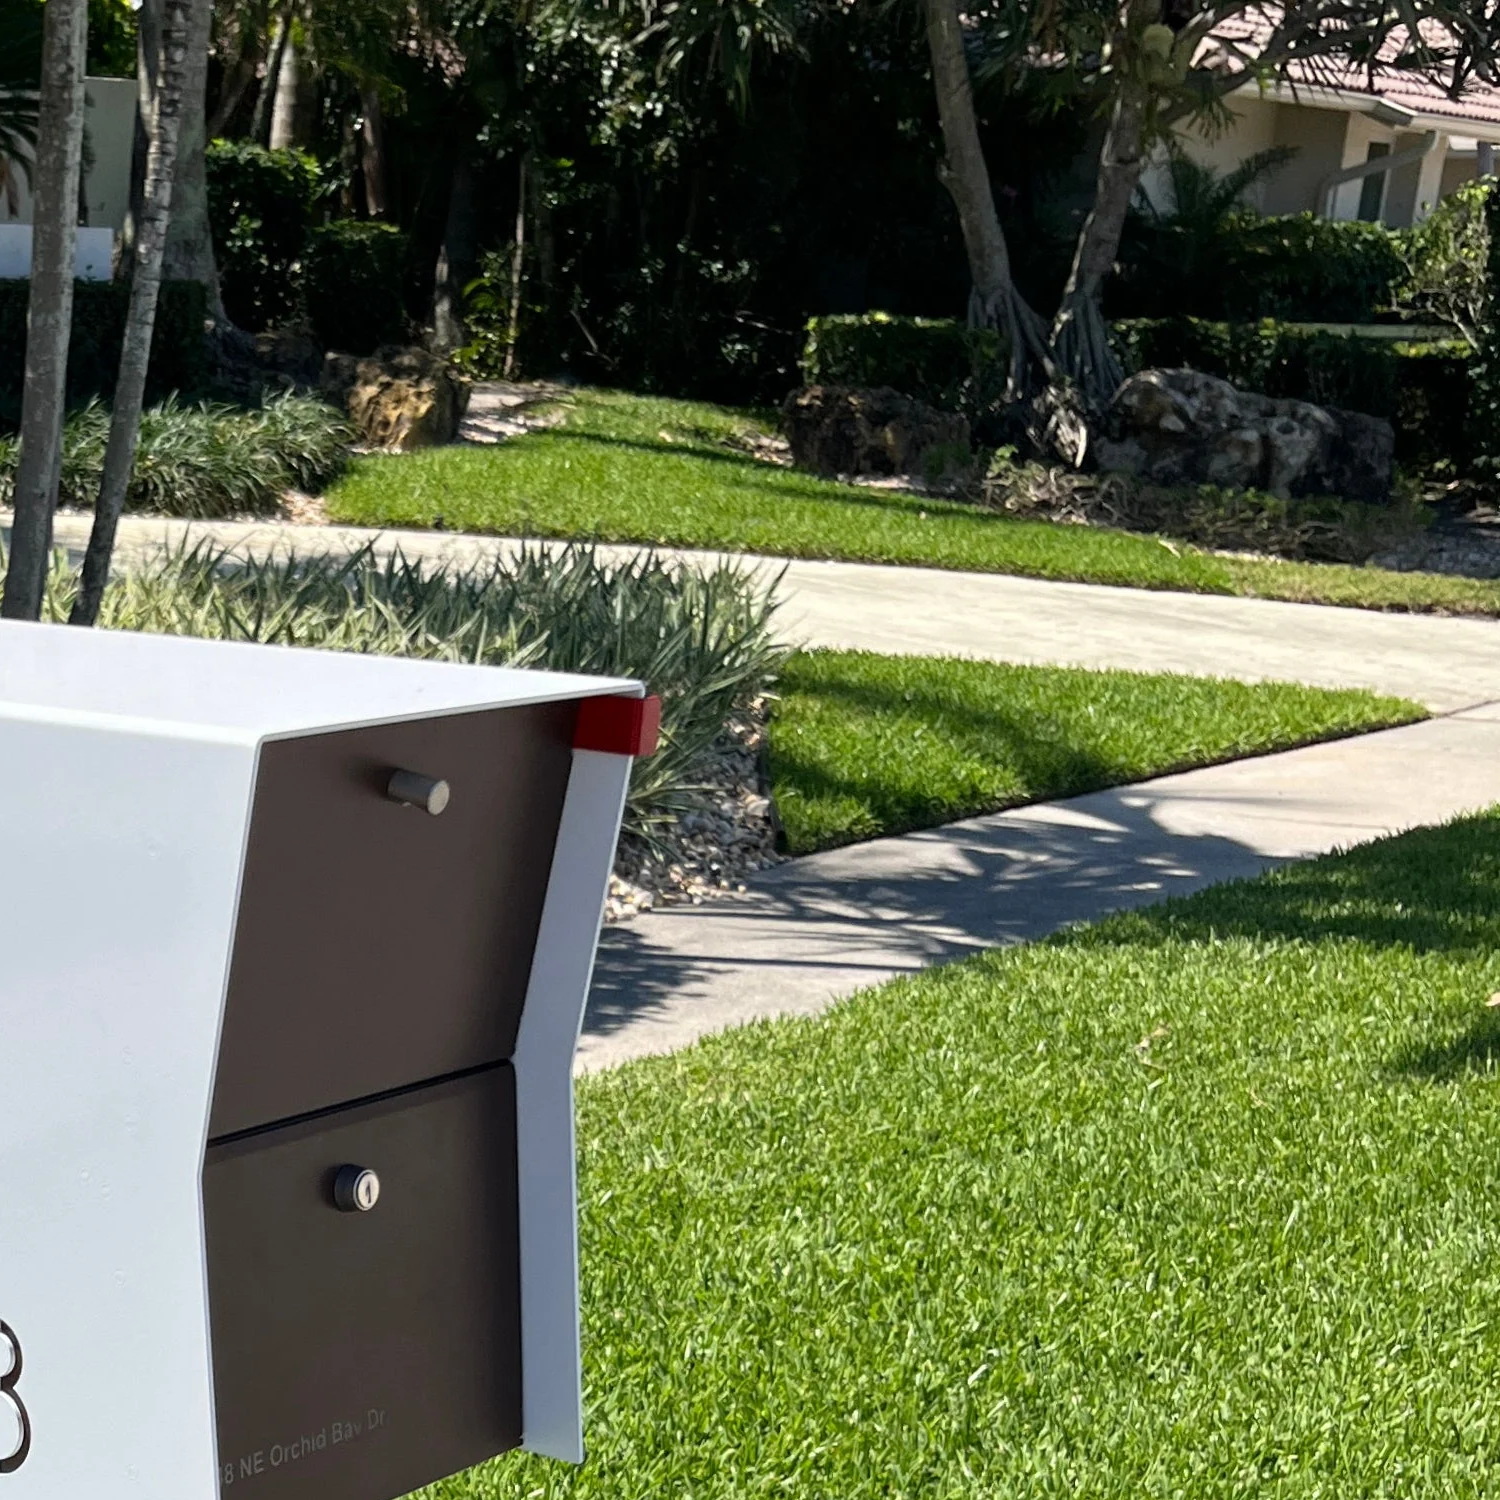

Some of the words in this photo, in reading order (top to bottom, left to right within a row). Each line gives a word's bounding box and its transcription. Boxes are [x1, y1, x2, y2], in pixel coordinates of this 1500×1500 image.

[240, 1451, 264, 1478] NE
[269, 1427, 327, 1467] Orchid
[367, 1408, 386, 1430] Dr
